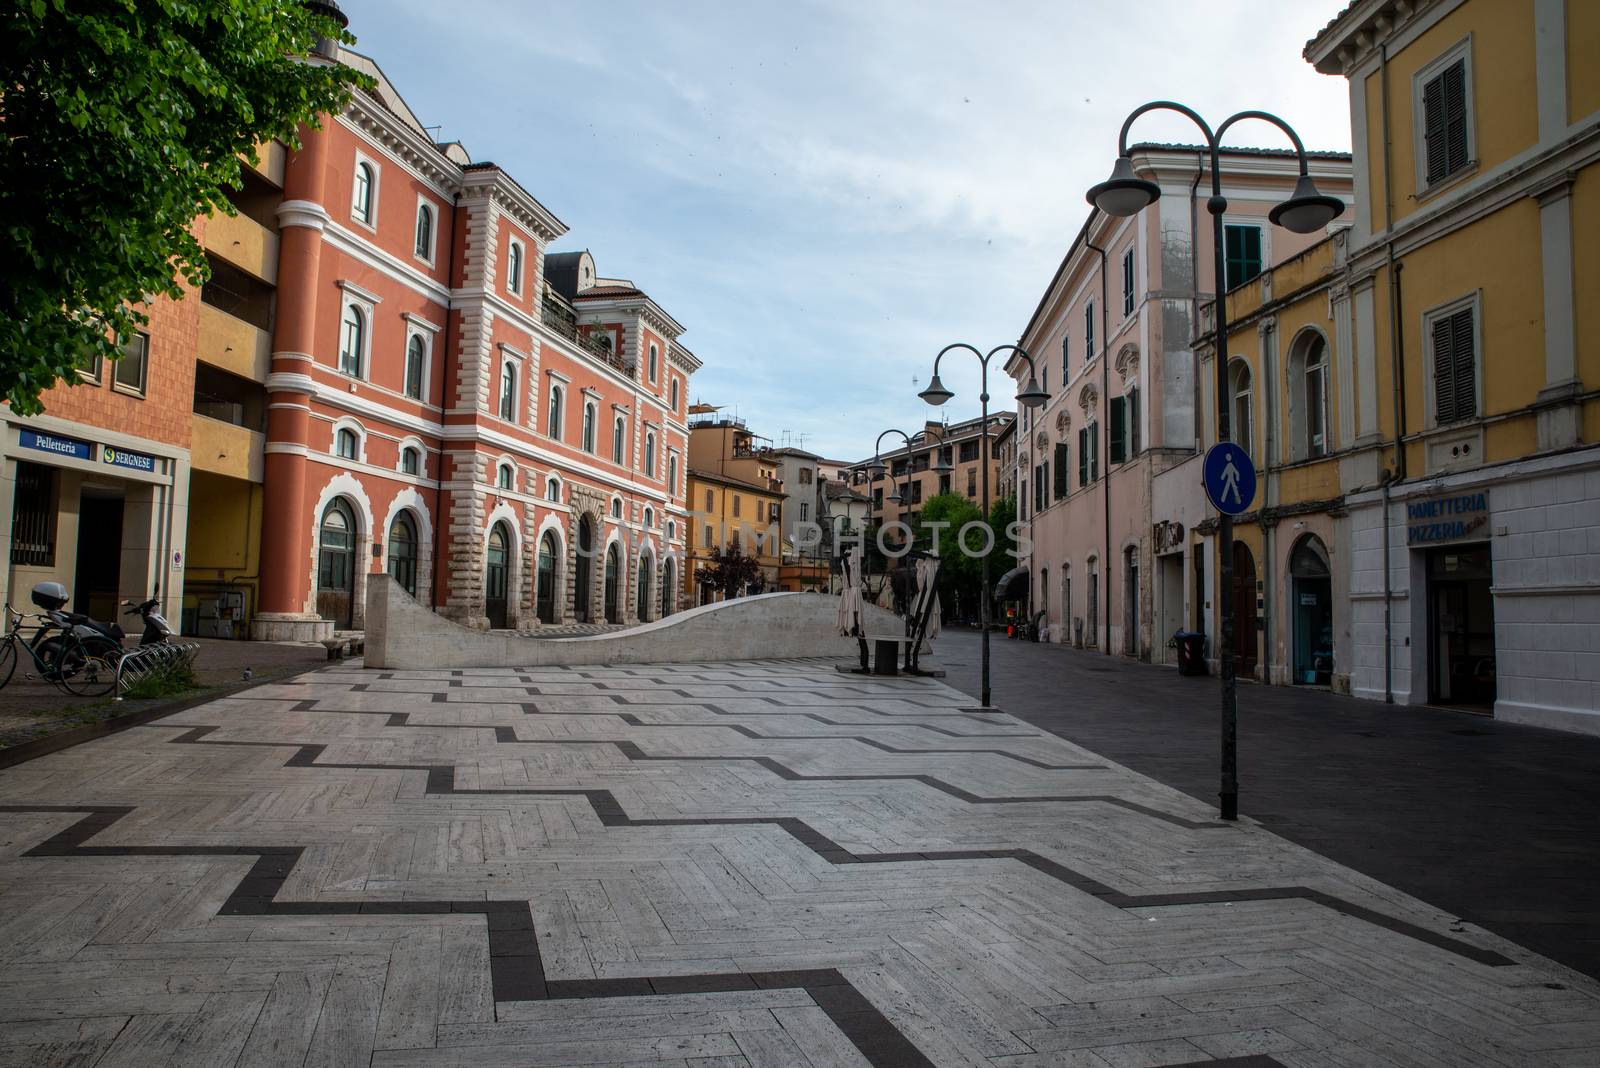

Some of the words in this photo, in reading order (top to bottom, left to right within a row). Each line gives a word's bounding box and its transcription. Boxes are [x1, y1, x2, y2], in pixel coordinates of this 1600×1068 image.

[36, 435, 76, 454] Pelletteria
[115, 451, 151, 469] SERGNESE
[1408, 493, 1487, 519] PANETTERIA
[1408, 521, 1466, 541] PIZZERIA
